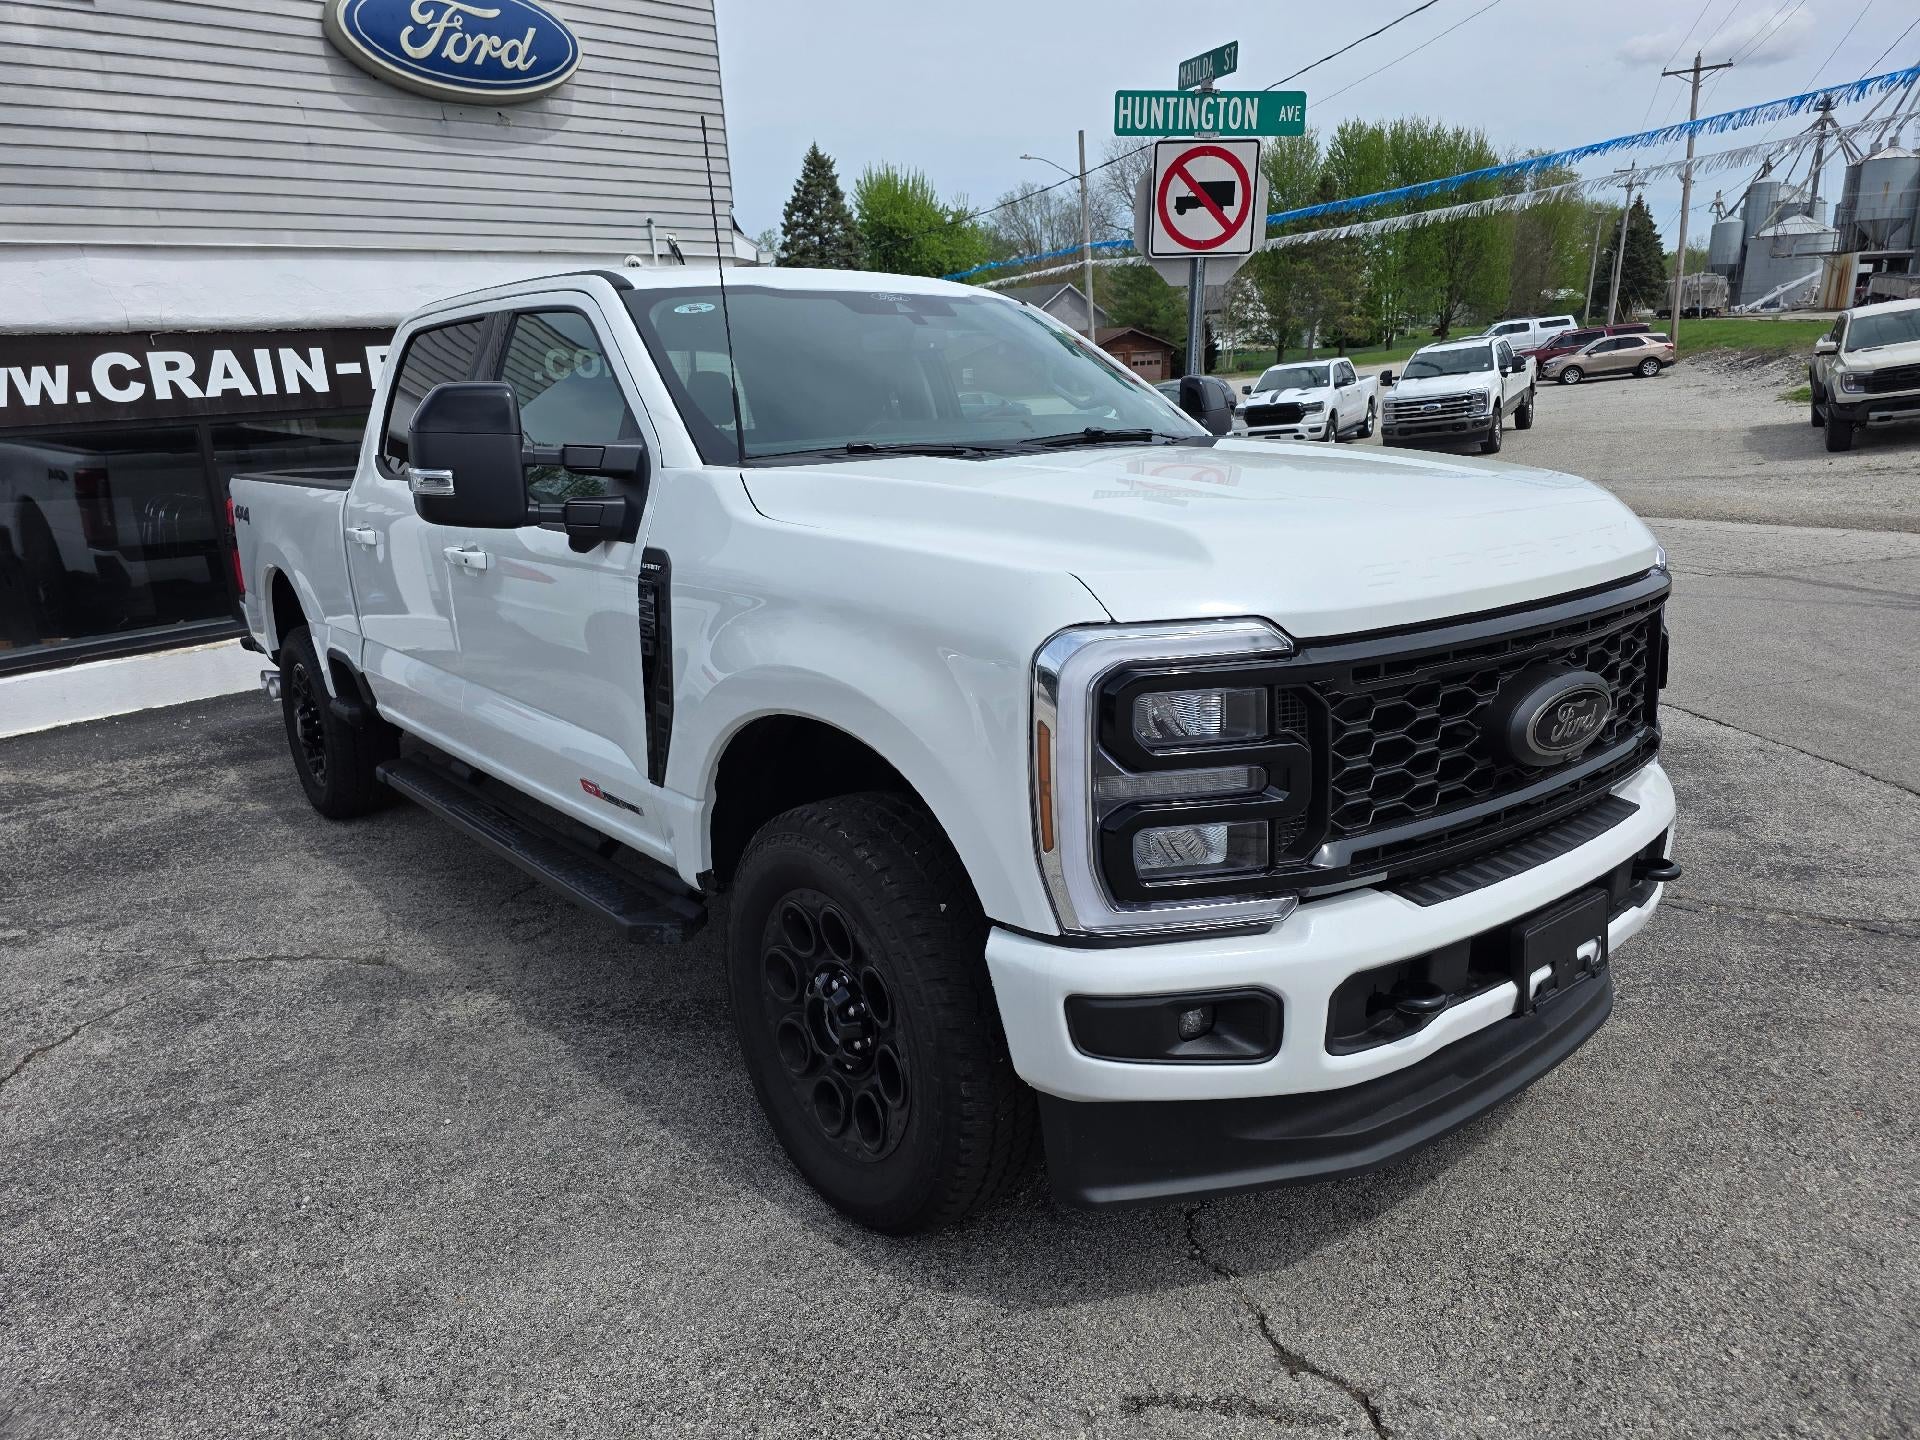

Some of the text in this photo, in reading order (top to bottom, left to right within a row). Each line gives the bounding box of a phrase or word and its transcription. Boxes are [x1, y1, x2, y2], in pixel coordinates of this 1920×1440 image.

[400, 0, 537, 71] Ford
[1179, 46, 1237, 88] MATILDA ST
[1118, 97, 1302, 129] HUNTINGTON AVE
[1551, 699, 1598, 742] Ford
